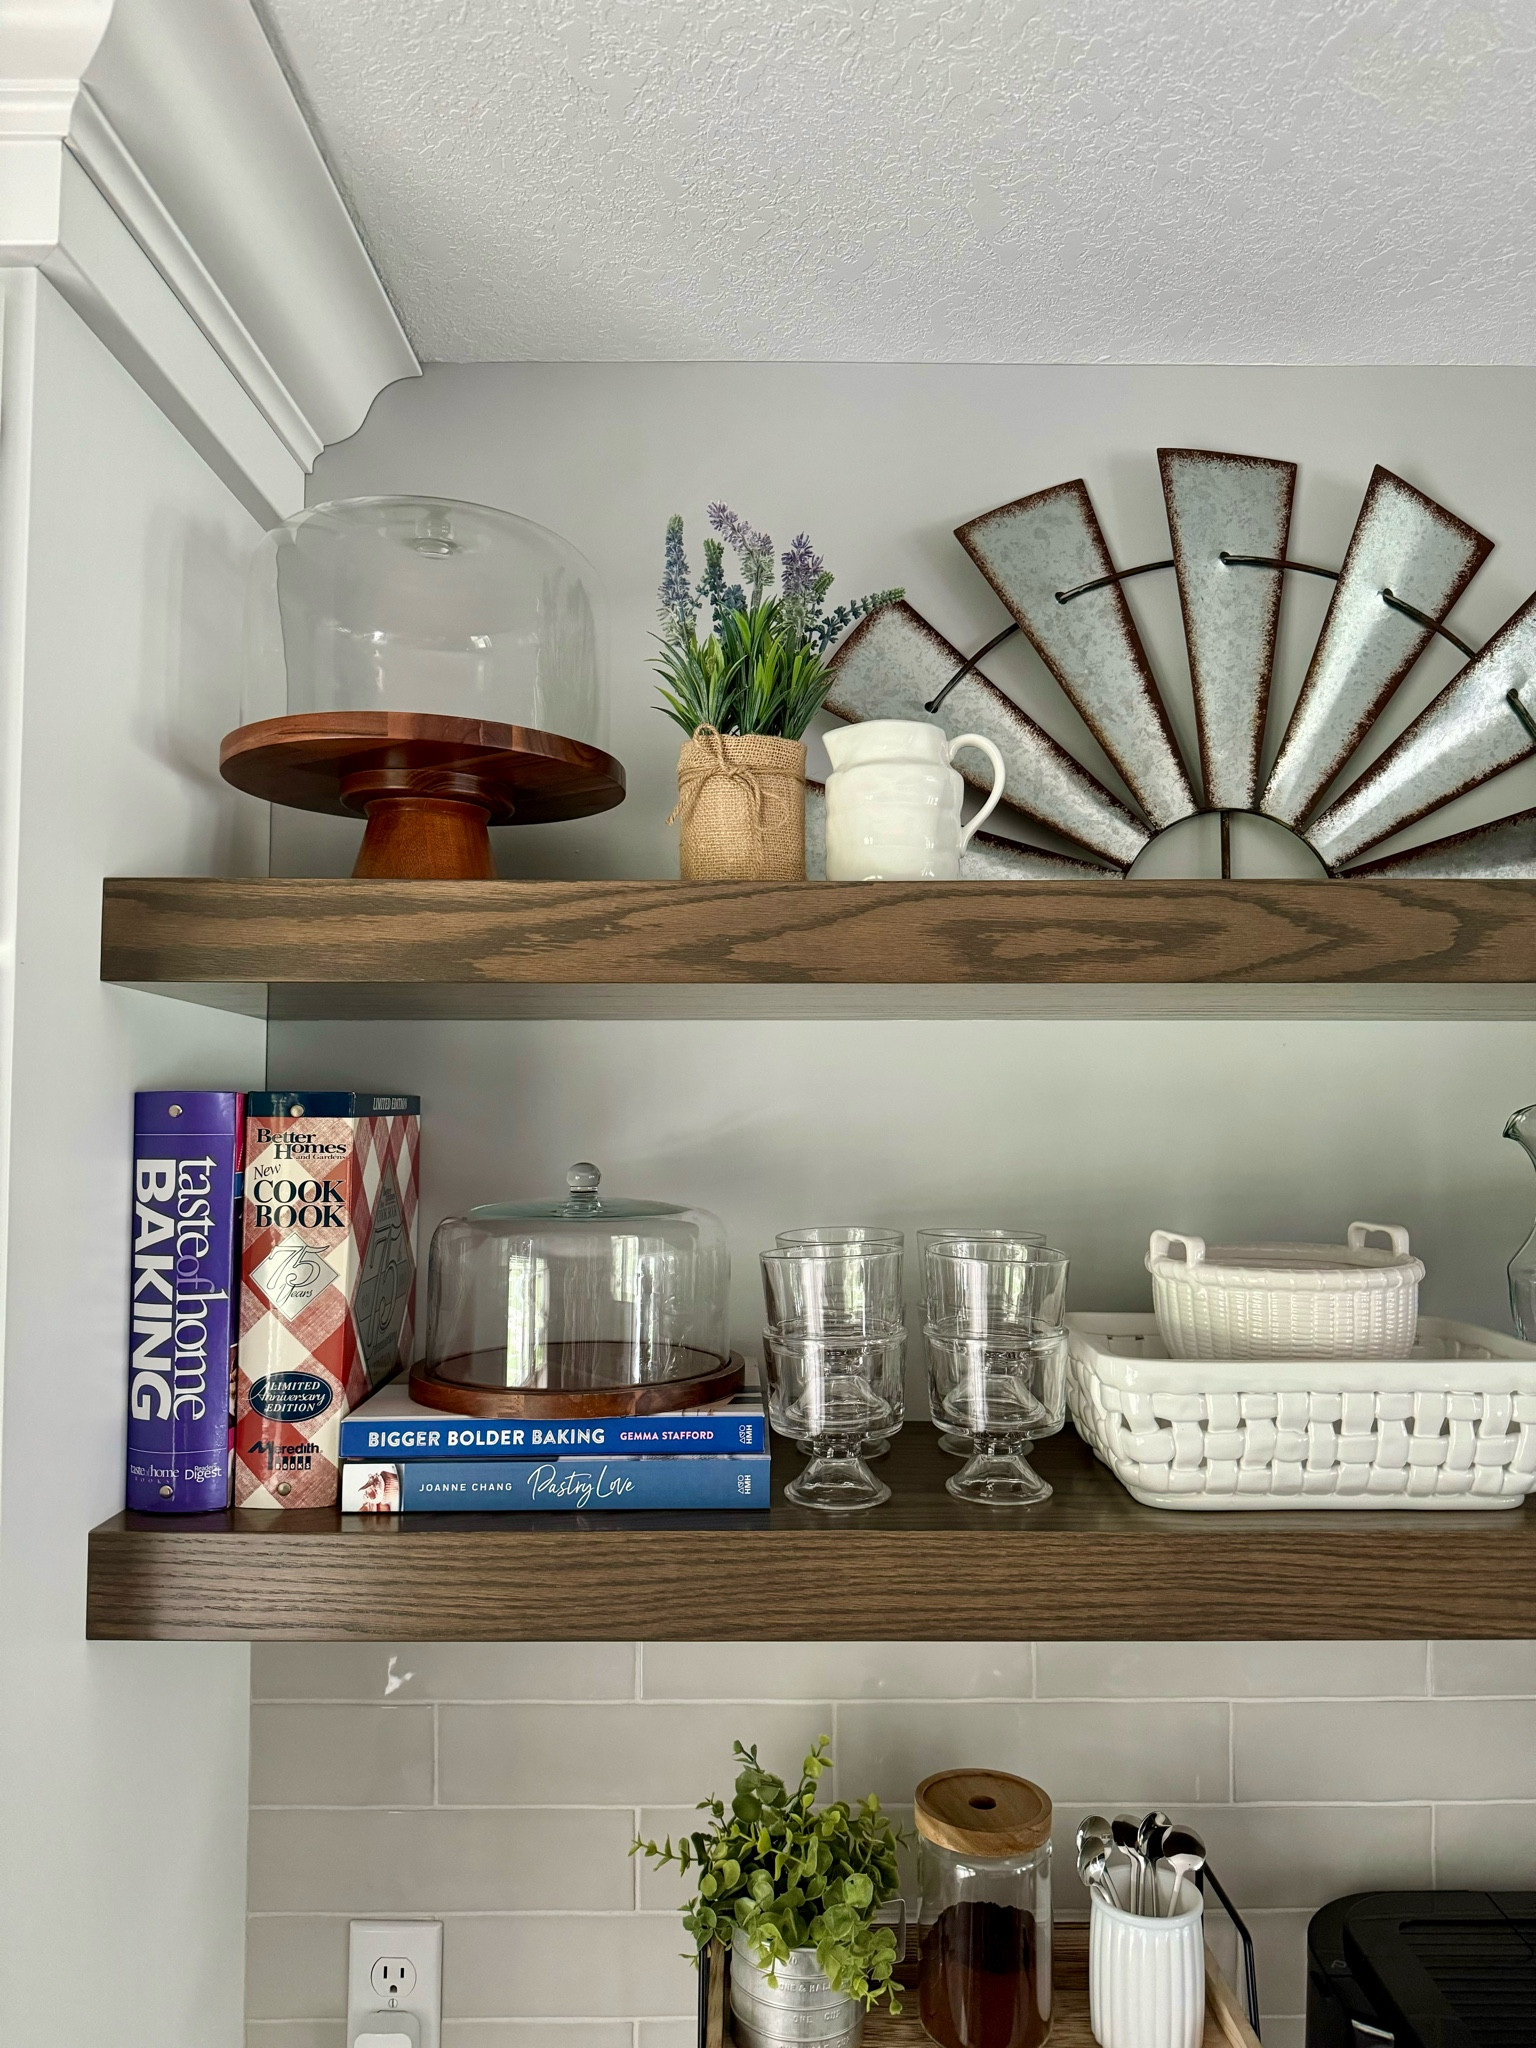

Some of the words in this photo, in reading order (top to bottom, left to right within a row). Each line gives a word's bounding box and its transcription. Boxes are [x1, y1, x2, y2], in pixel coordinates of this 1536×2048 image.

[256, 1128, 317, 1144] Better
[273, 1143, 347, 1160] Homes
[253, 1163, 282, 1180] New
[253, 1179, 345, 1204] COOK
[254, 1204, 346, 1229] BOOK
[266, 1244, 330, 1291] 75
[131, 1159, 177, 1421] BAKING
[272, 1283, 314, 1309] Years
[246, 1381, 326, 1406] Anniversary
[269, 1381, 321, 1391] LIMITED
[265, 1403, 316, 1413] EDITION
[368, 1430, 441, 1448] BIGGER
[447, 1429, 524, 1447] BOLDER
[531, 1428, 605, 1446] BAKING
[620, 1431, 659, 1441] GEMMA
[661, 1431, 714, 1441] STAFFORD
[745, 1424, 753, 1445] HMH
[248, 1441, 320, 1470] Meredith
[184, 1468, 222, 1483] Digest
[275, 1462, 311, 1470] BOOKS
[419, 1483, 467, 1492] JOANNE
[471, 1482, 513, 1491] CHANG
[527, 1464, 594, 1509] Pastry
[595, 1464, 635, 1498] Love
